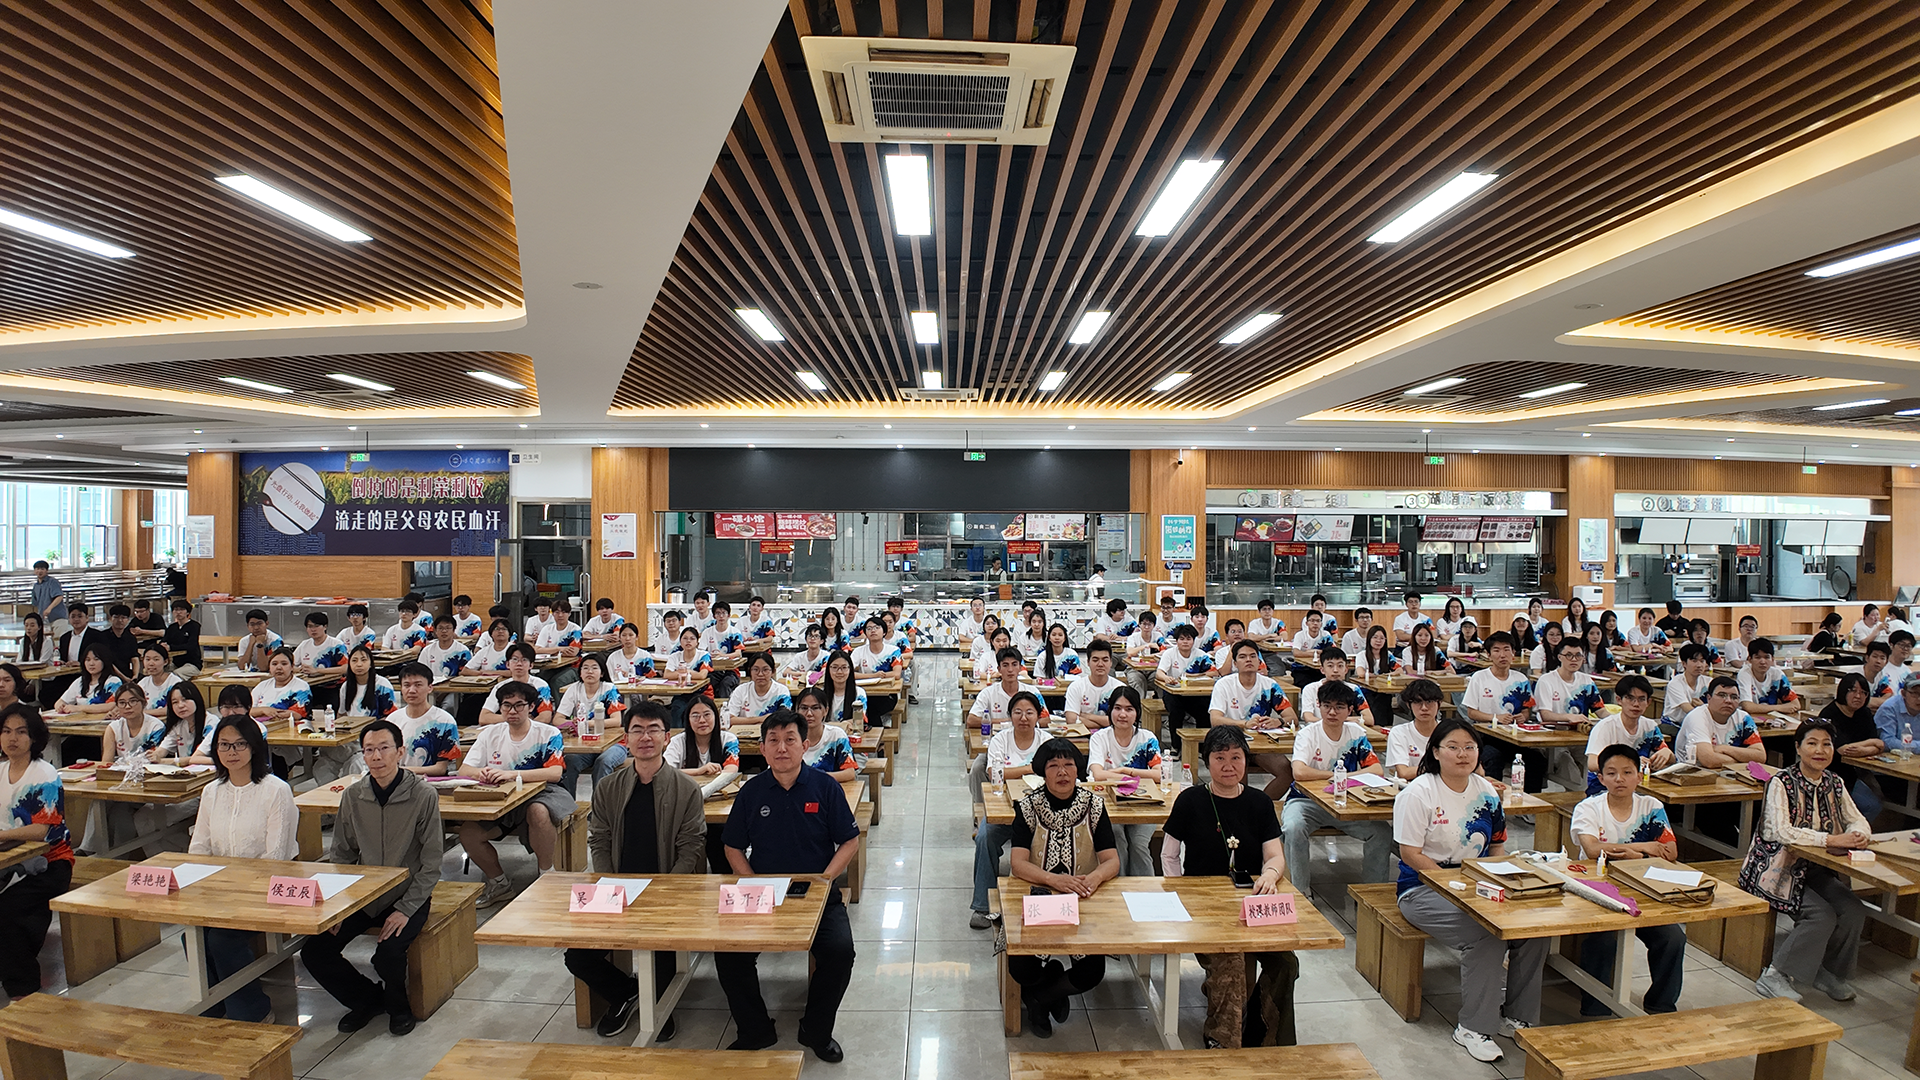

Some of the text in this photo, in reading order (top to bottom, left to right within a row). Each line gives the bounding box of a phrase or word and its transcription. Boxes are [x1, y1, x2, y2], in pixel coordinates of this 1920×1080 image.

[351, 476, 484, 499] 倒掉的是剩菜剩饭
[335, 510, 501, 531] 流走的是父母农民血汗
[722, 514, 765, 523] 一碟小馆
[131, 872, 167, 888] 梁艳艳
[271, 883, 311, 899] 侯宜辰
[1248, 902, 1294, 919] 授课教师团队
